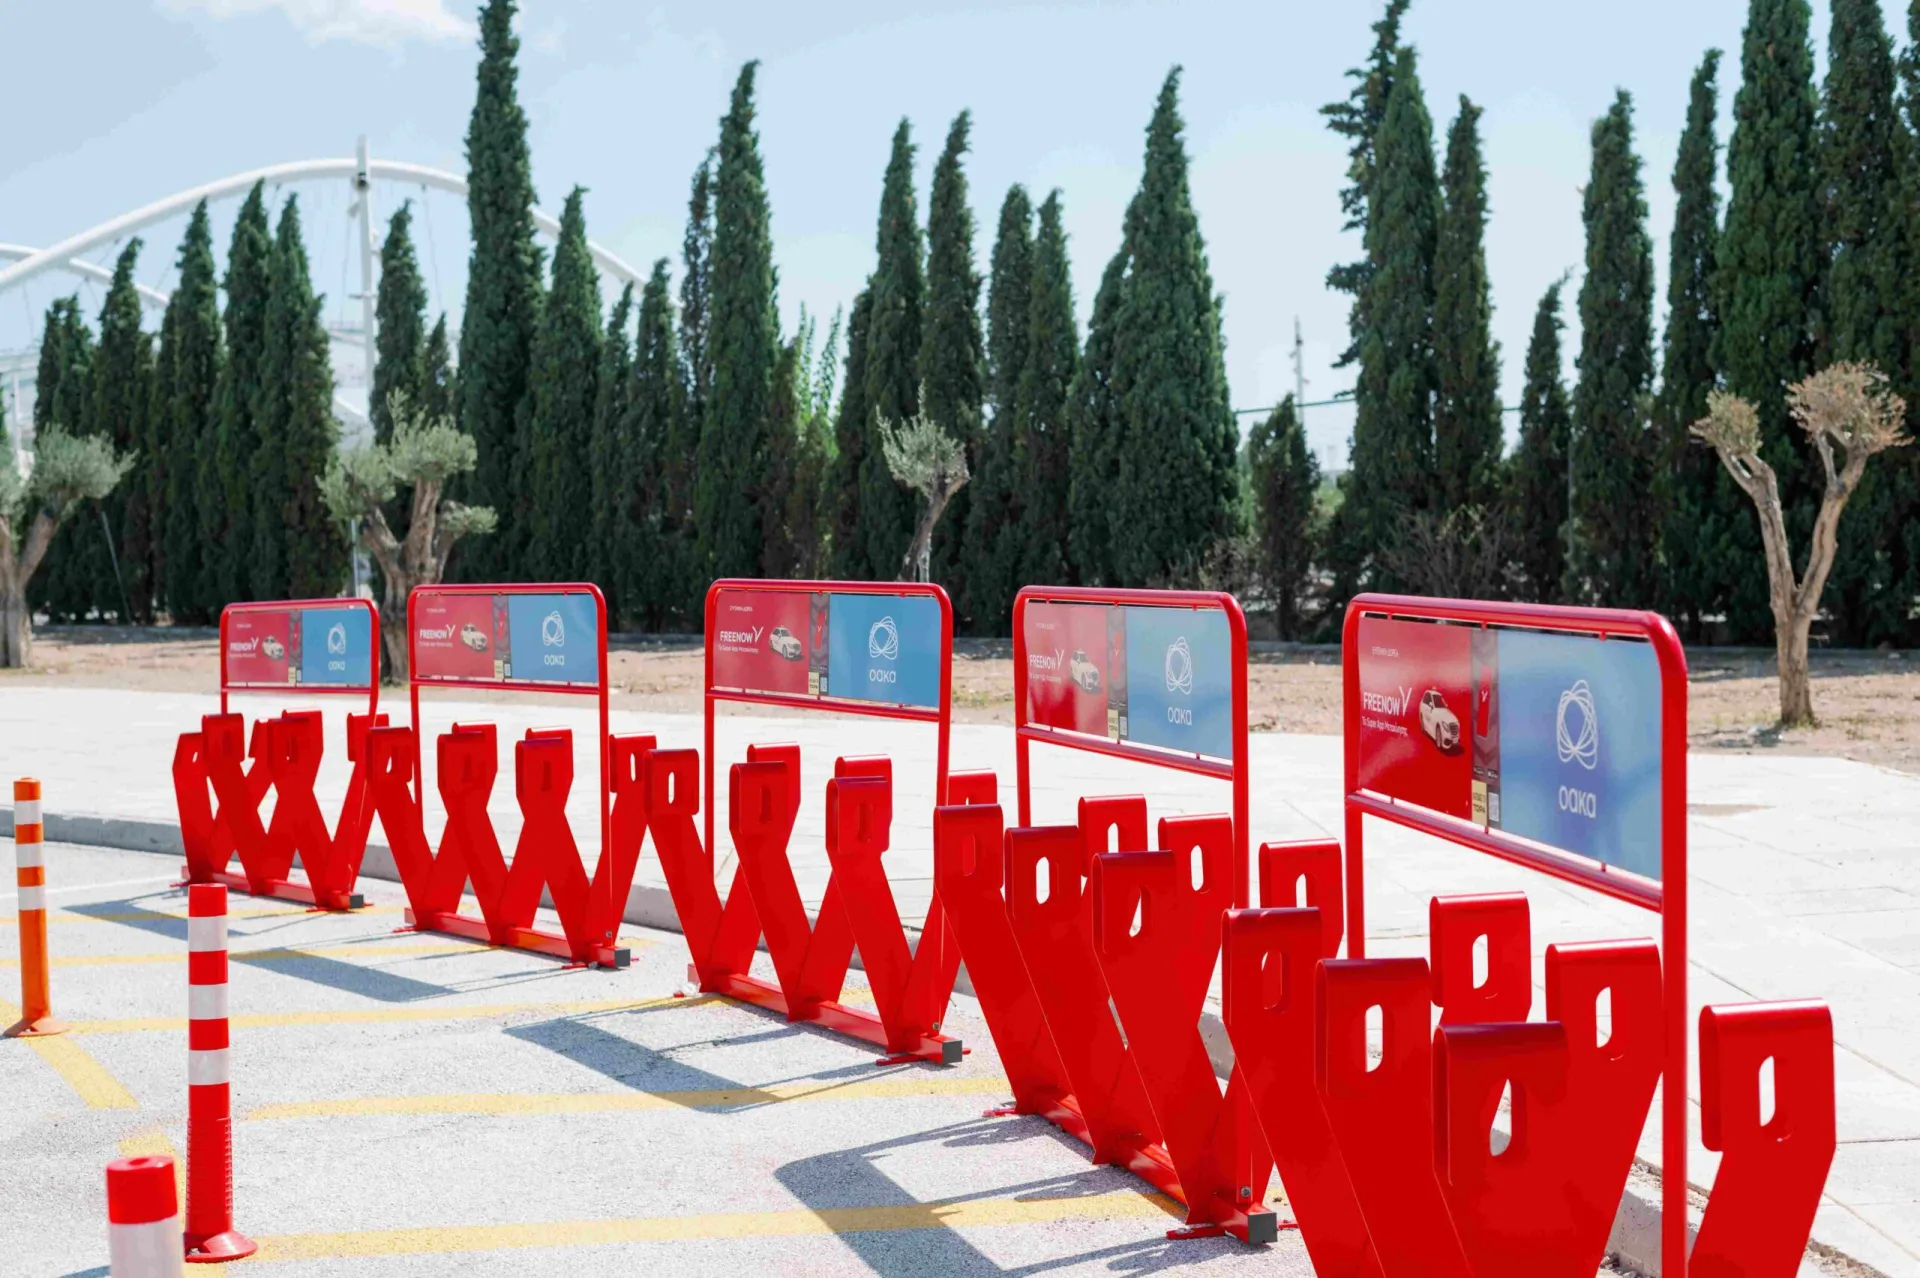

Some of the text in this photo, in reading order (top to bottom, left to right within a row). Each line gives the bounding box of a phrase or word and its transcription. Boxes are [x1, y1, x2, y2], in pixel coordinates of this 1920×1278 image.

[420, 629, 447, 640] FREENOW
[720, 630, 753, 644] FREENOW
[1030, 654, 1056, 670] FREENOW
[1363, 691, 1401, 717] FREENOW
